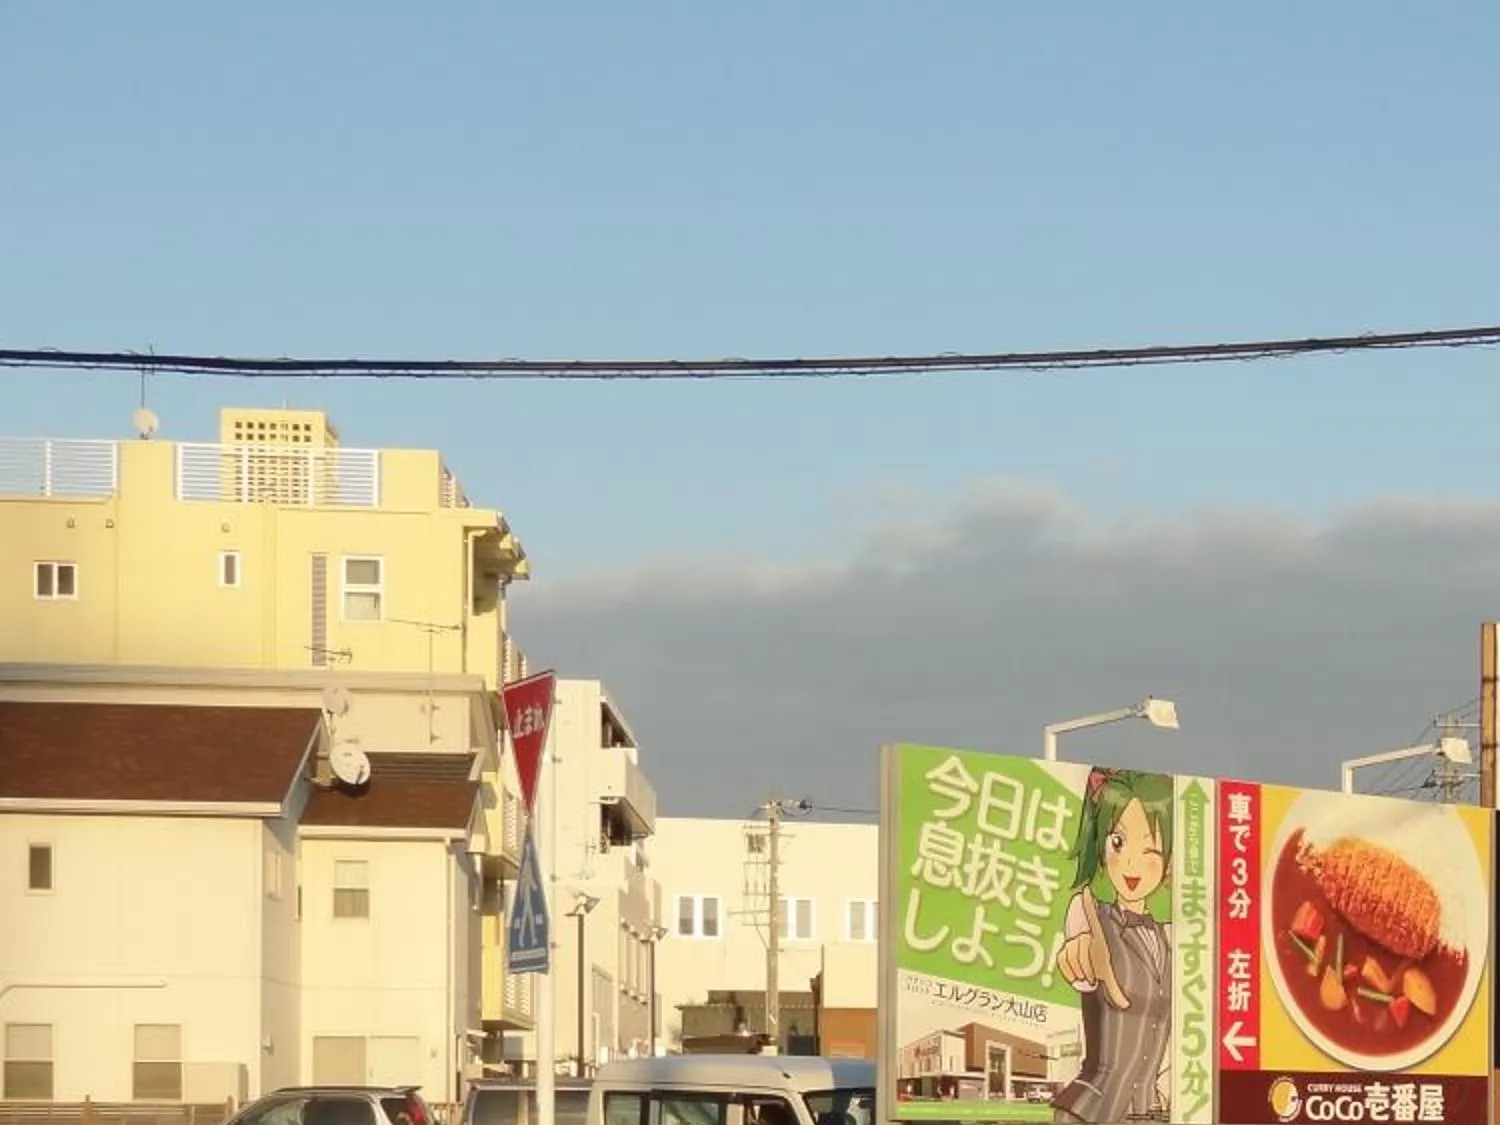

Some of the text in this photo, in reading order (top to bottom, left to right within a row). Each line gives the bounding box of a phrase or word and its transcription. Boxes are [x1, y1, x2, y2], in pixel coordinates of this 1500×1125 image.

[514, 704, 546, 739] 止まれ
[925, 755, 1074, 852] 今日は
[911, 819, 1061, 909] 息抜き
[1227, 792, 1252, 1012] 車で3分 左折
